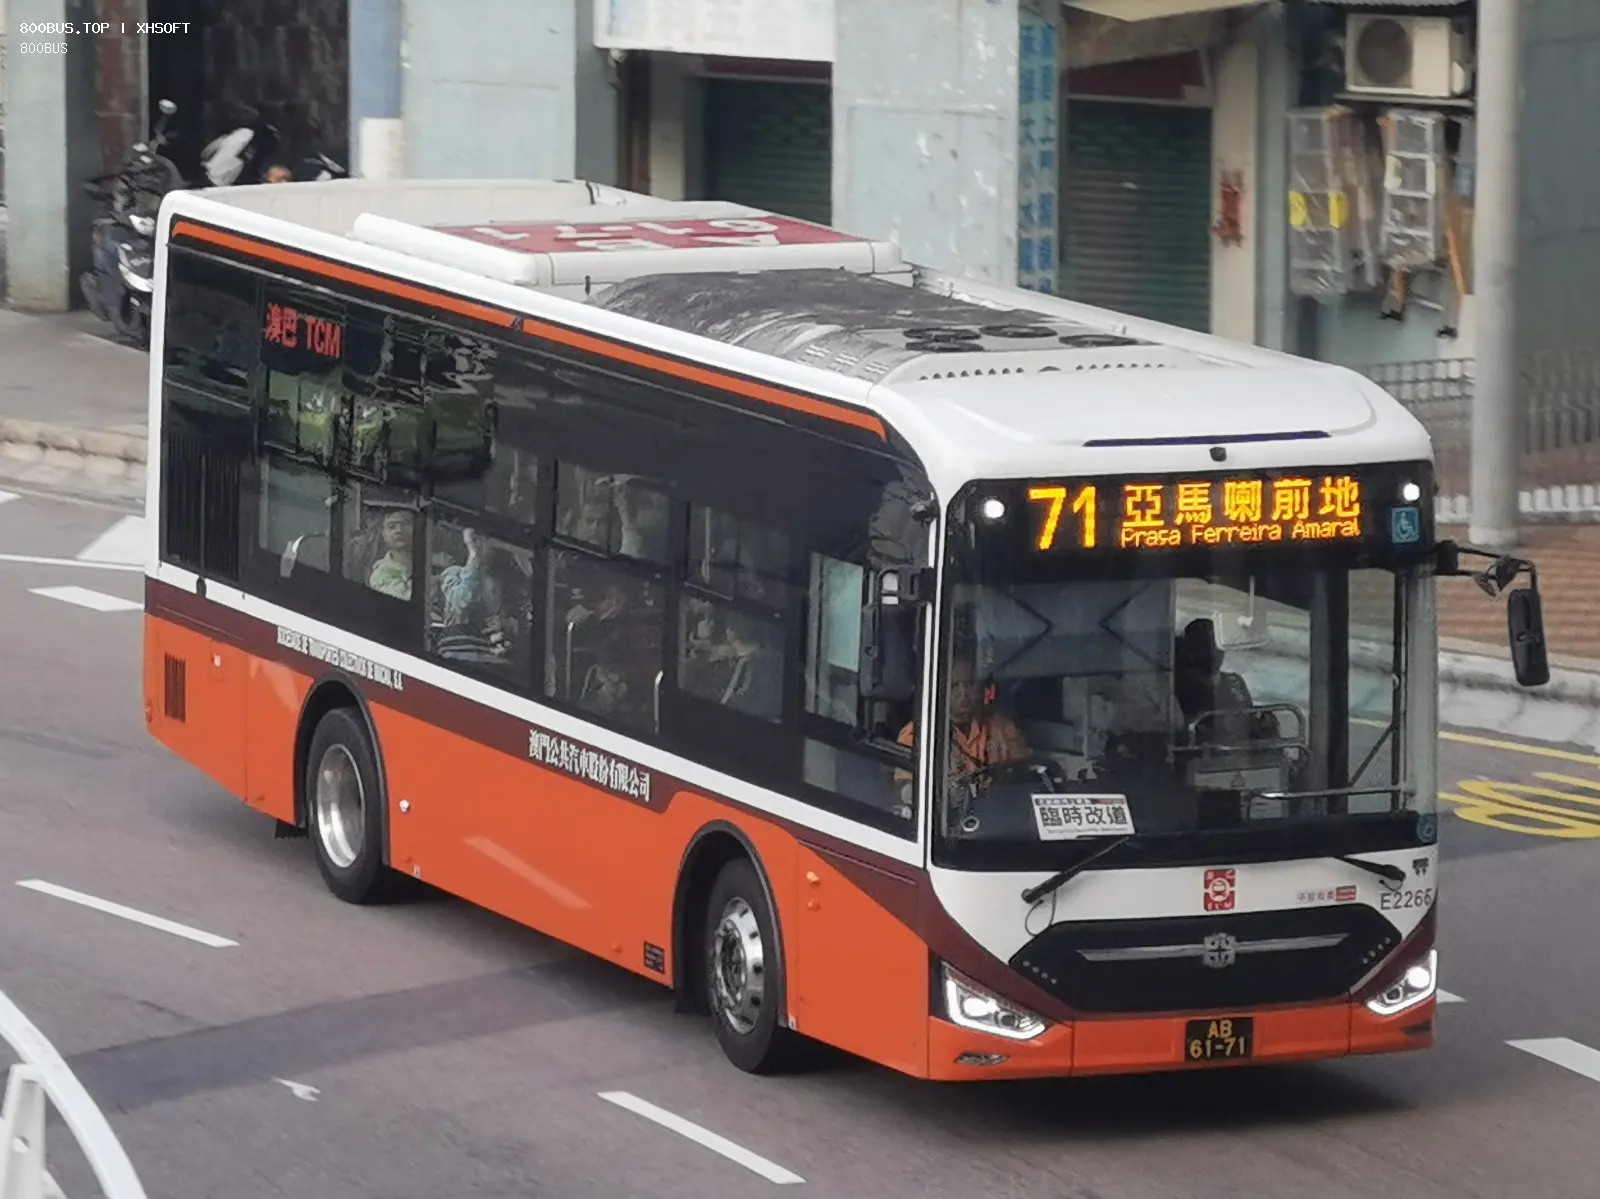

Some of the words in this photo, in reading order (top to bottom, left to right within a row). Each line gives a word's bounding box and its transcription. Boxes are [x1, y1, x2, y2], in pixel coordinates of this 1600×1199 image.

[303, 314, 342, 359] TCM
[1122, 476, 1361, 527] 亞馬喇前地
[1028, 486, 1096, 550] 71
[1191, 523, 1282, 545] Ferreira
[1291, 517, 1361, 540] Amaral
[1039, 805, 1128, 827] 臨時改道
[1207, 1019, 1233, 1038] AB
[1189, 1036, 1245, 1059] 61-71
